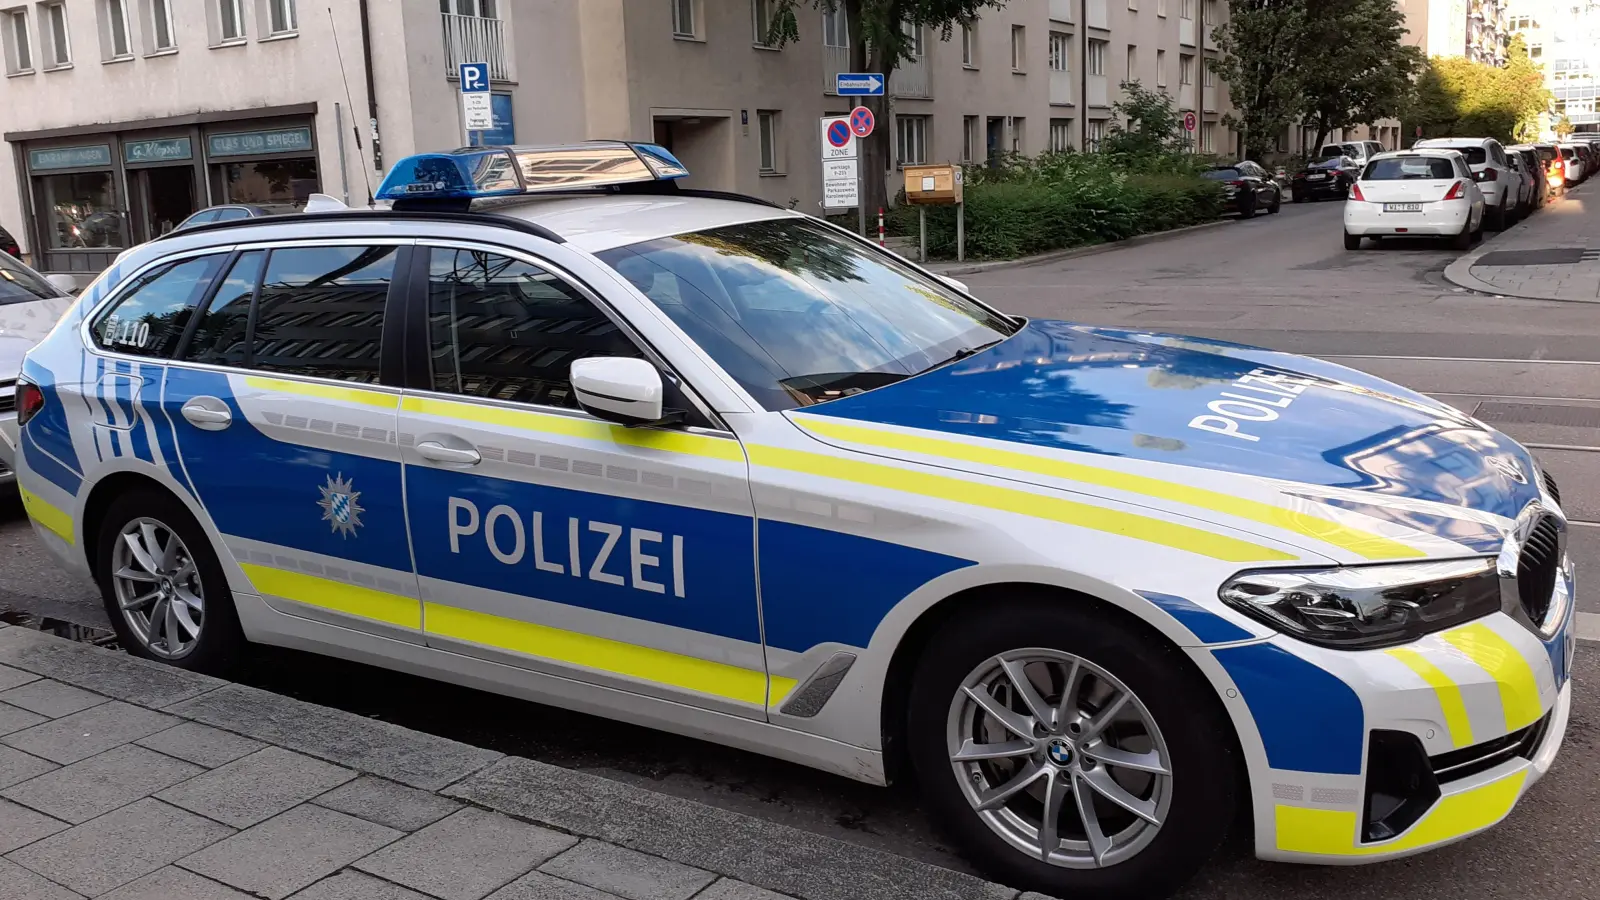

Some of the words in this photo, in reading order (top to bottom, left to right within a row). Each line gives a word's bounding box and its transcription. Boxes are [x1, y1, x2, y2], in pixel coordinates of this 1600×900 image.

[464, 66, 480, 89] P
[242, 135, 263, 148] UND
[266, 132, 306, 146] SPIEGEL
[830, 148, 849, 157] ZONE
[119, 320, 150, 348] 110
[1187, 366, 1319, 442] POLIZEI
[447, 495, 686, 599] POLIZEI
